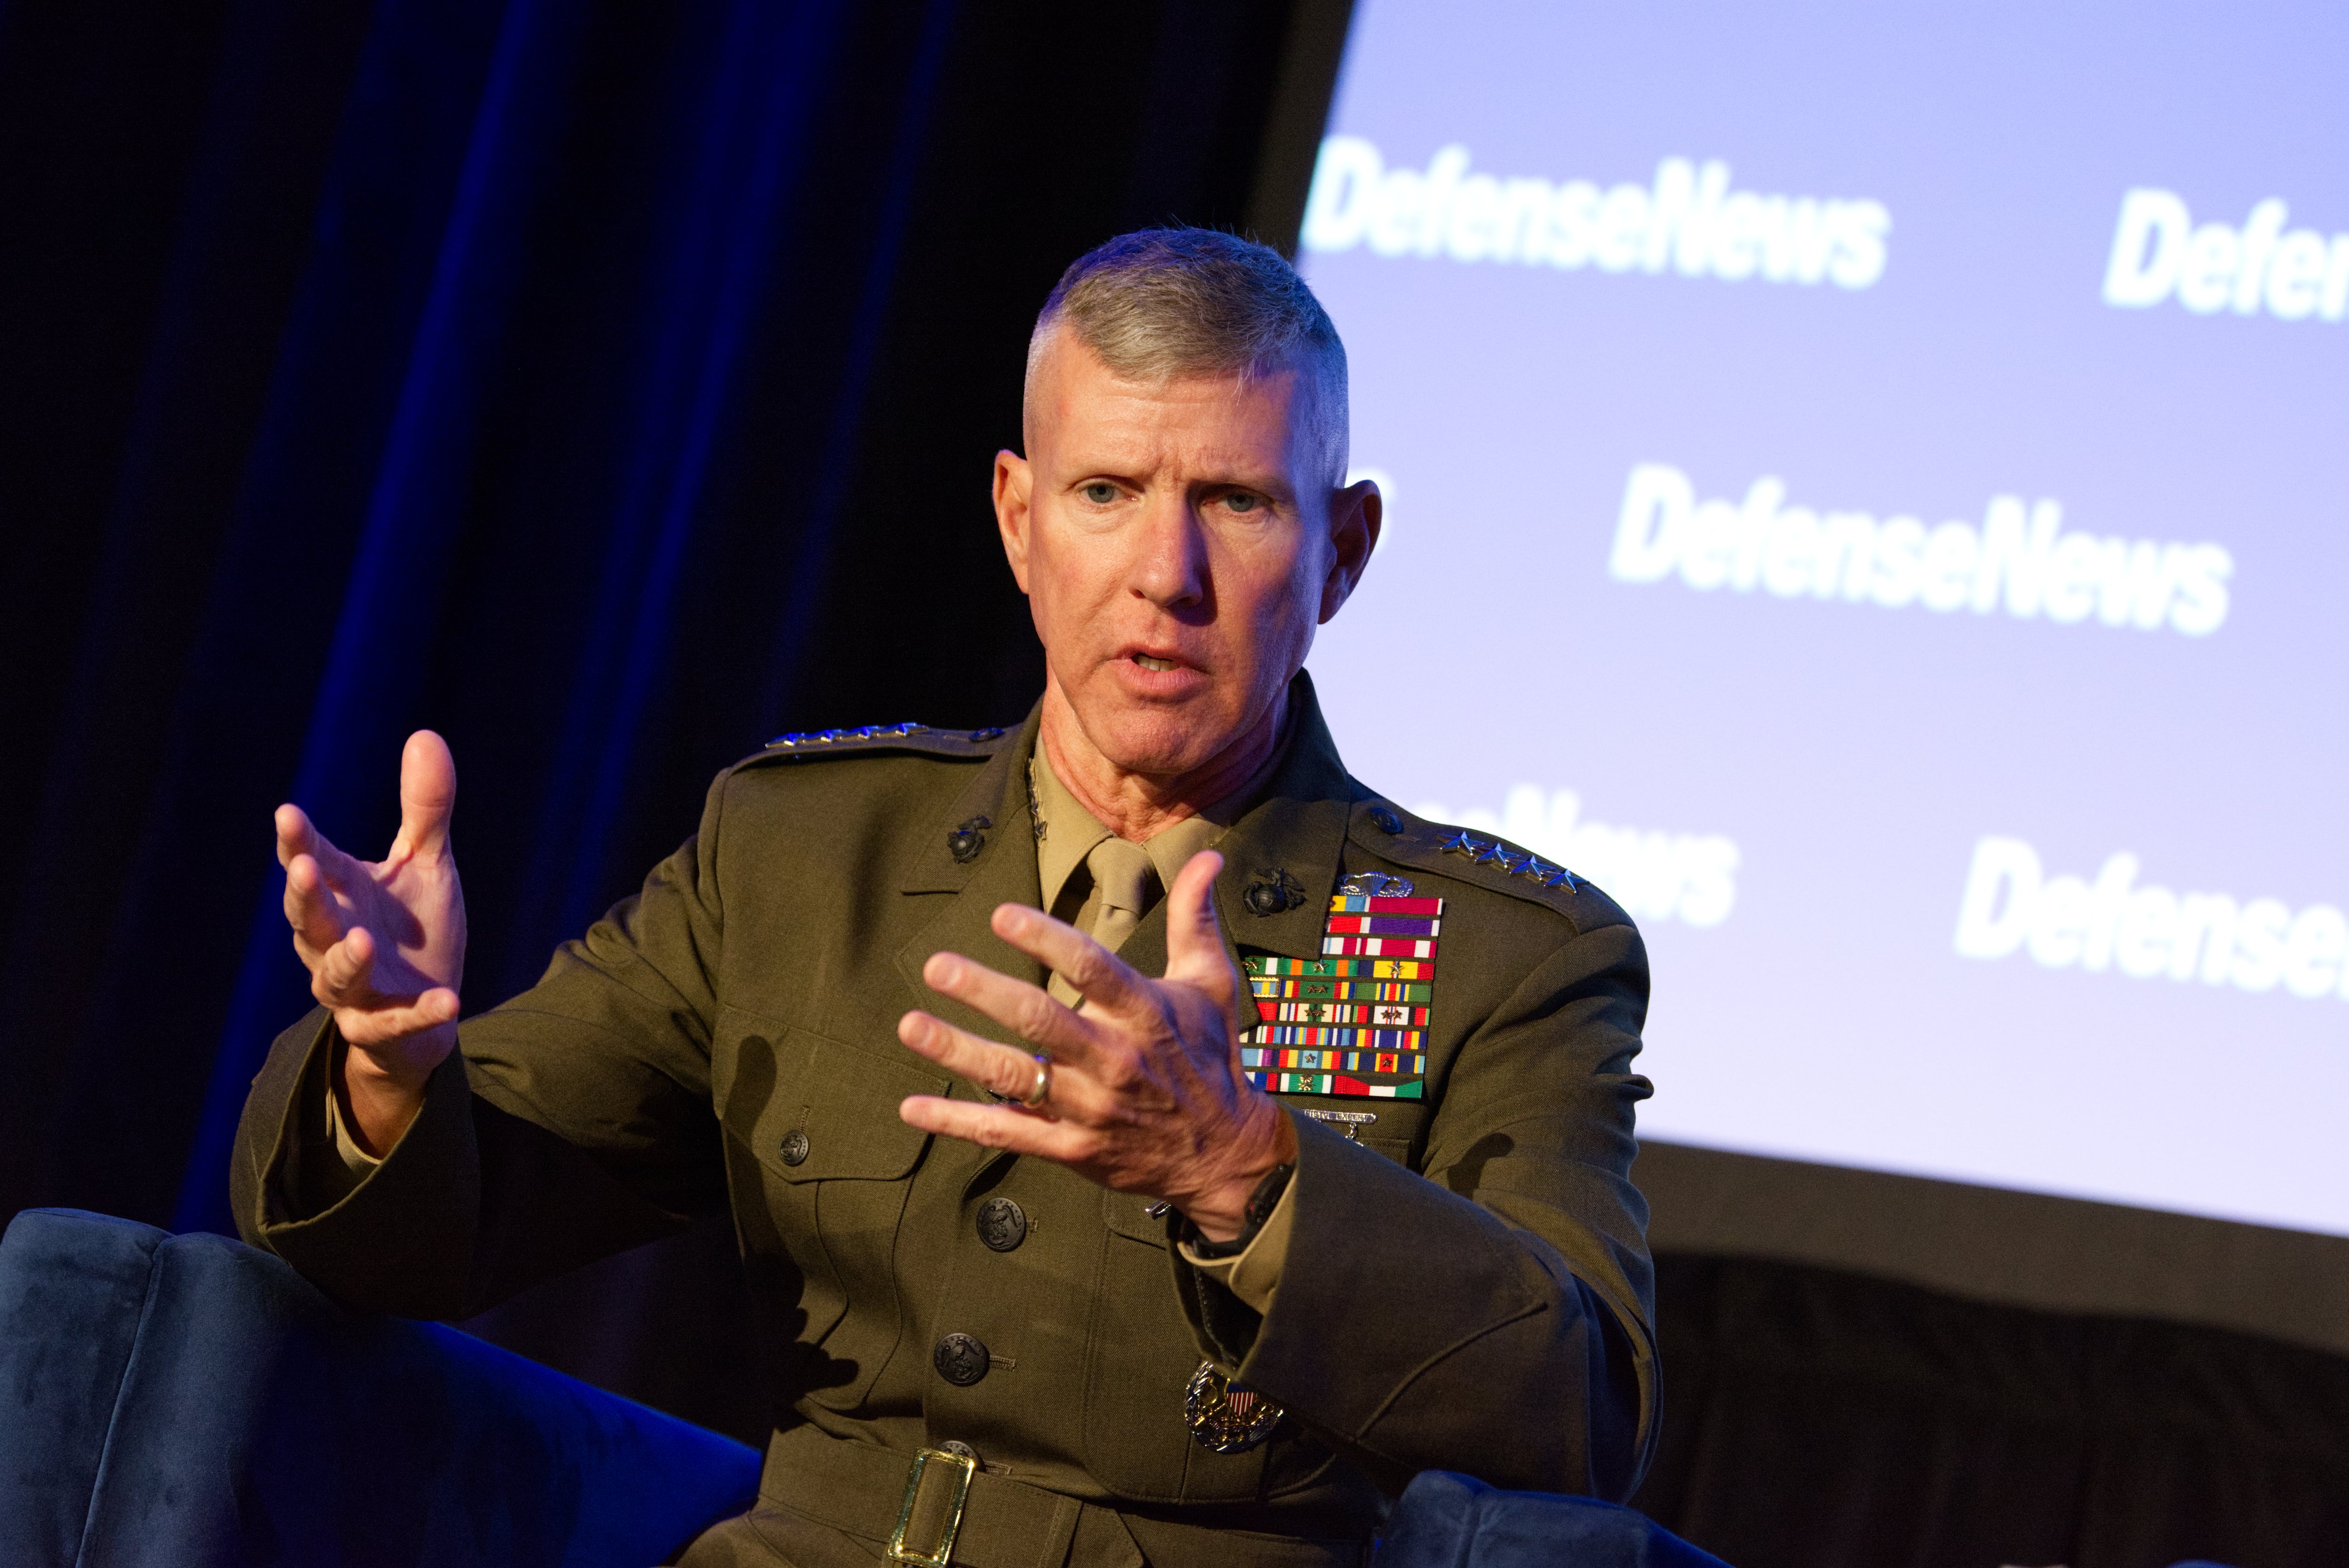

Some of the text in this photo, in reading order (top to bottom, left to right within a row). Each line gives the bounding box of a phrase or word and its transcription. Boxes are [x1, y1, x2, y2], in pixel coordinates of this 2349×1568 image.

[1301, 136, 1892, 290] DefenseNews
[1609, 462, 2233, 634] DefenseNews
[1336, 1112, 1368, 1121] EXPERT
